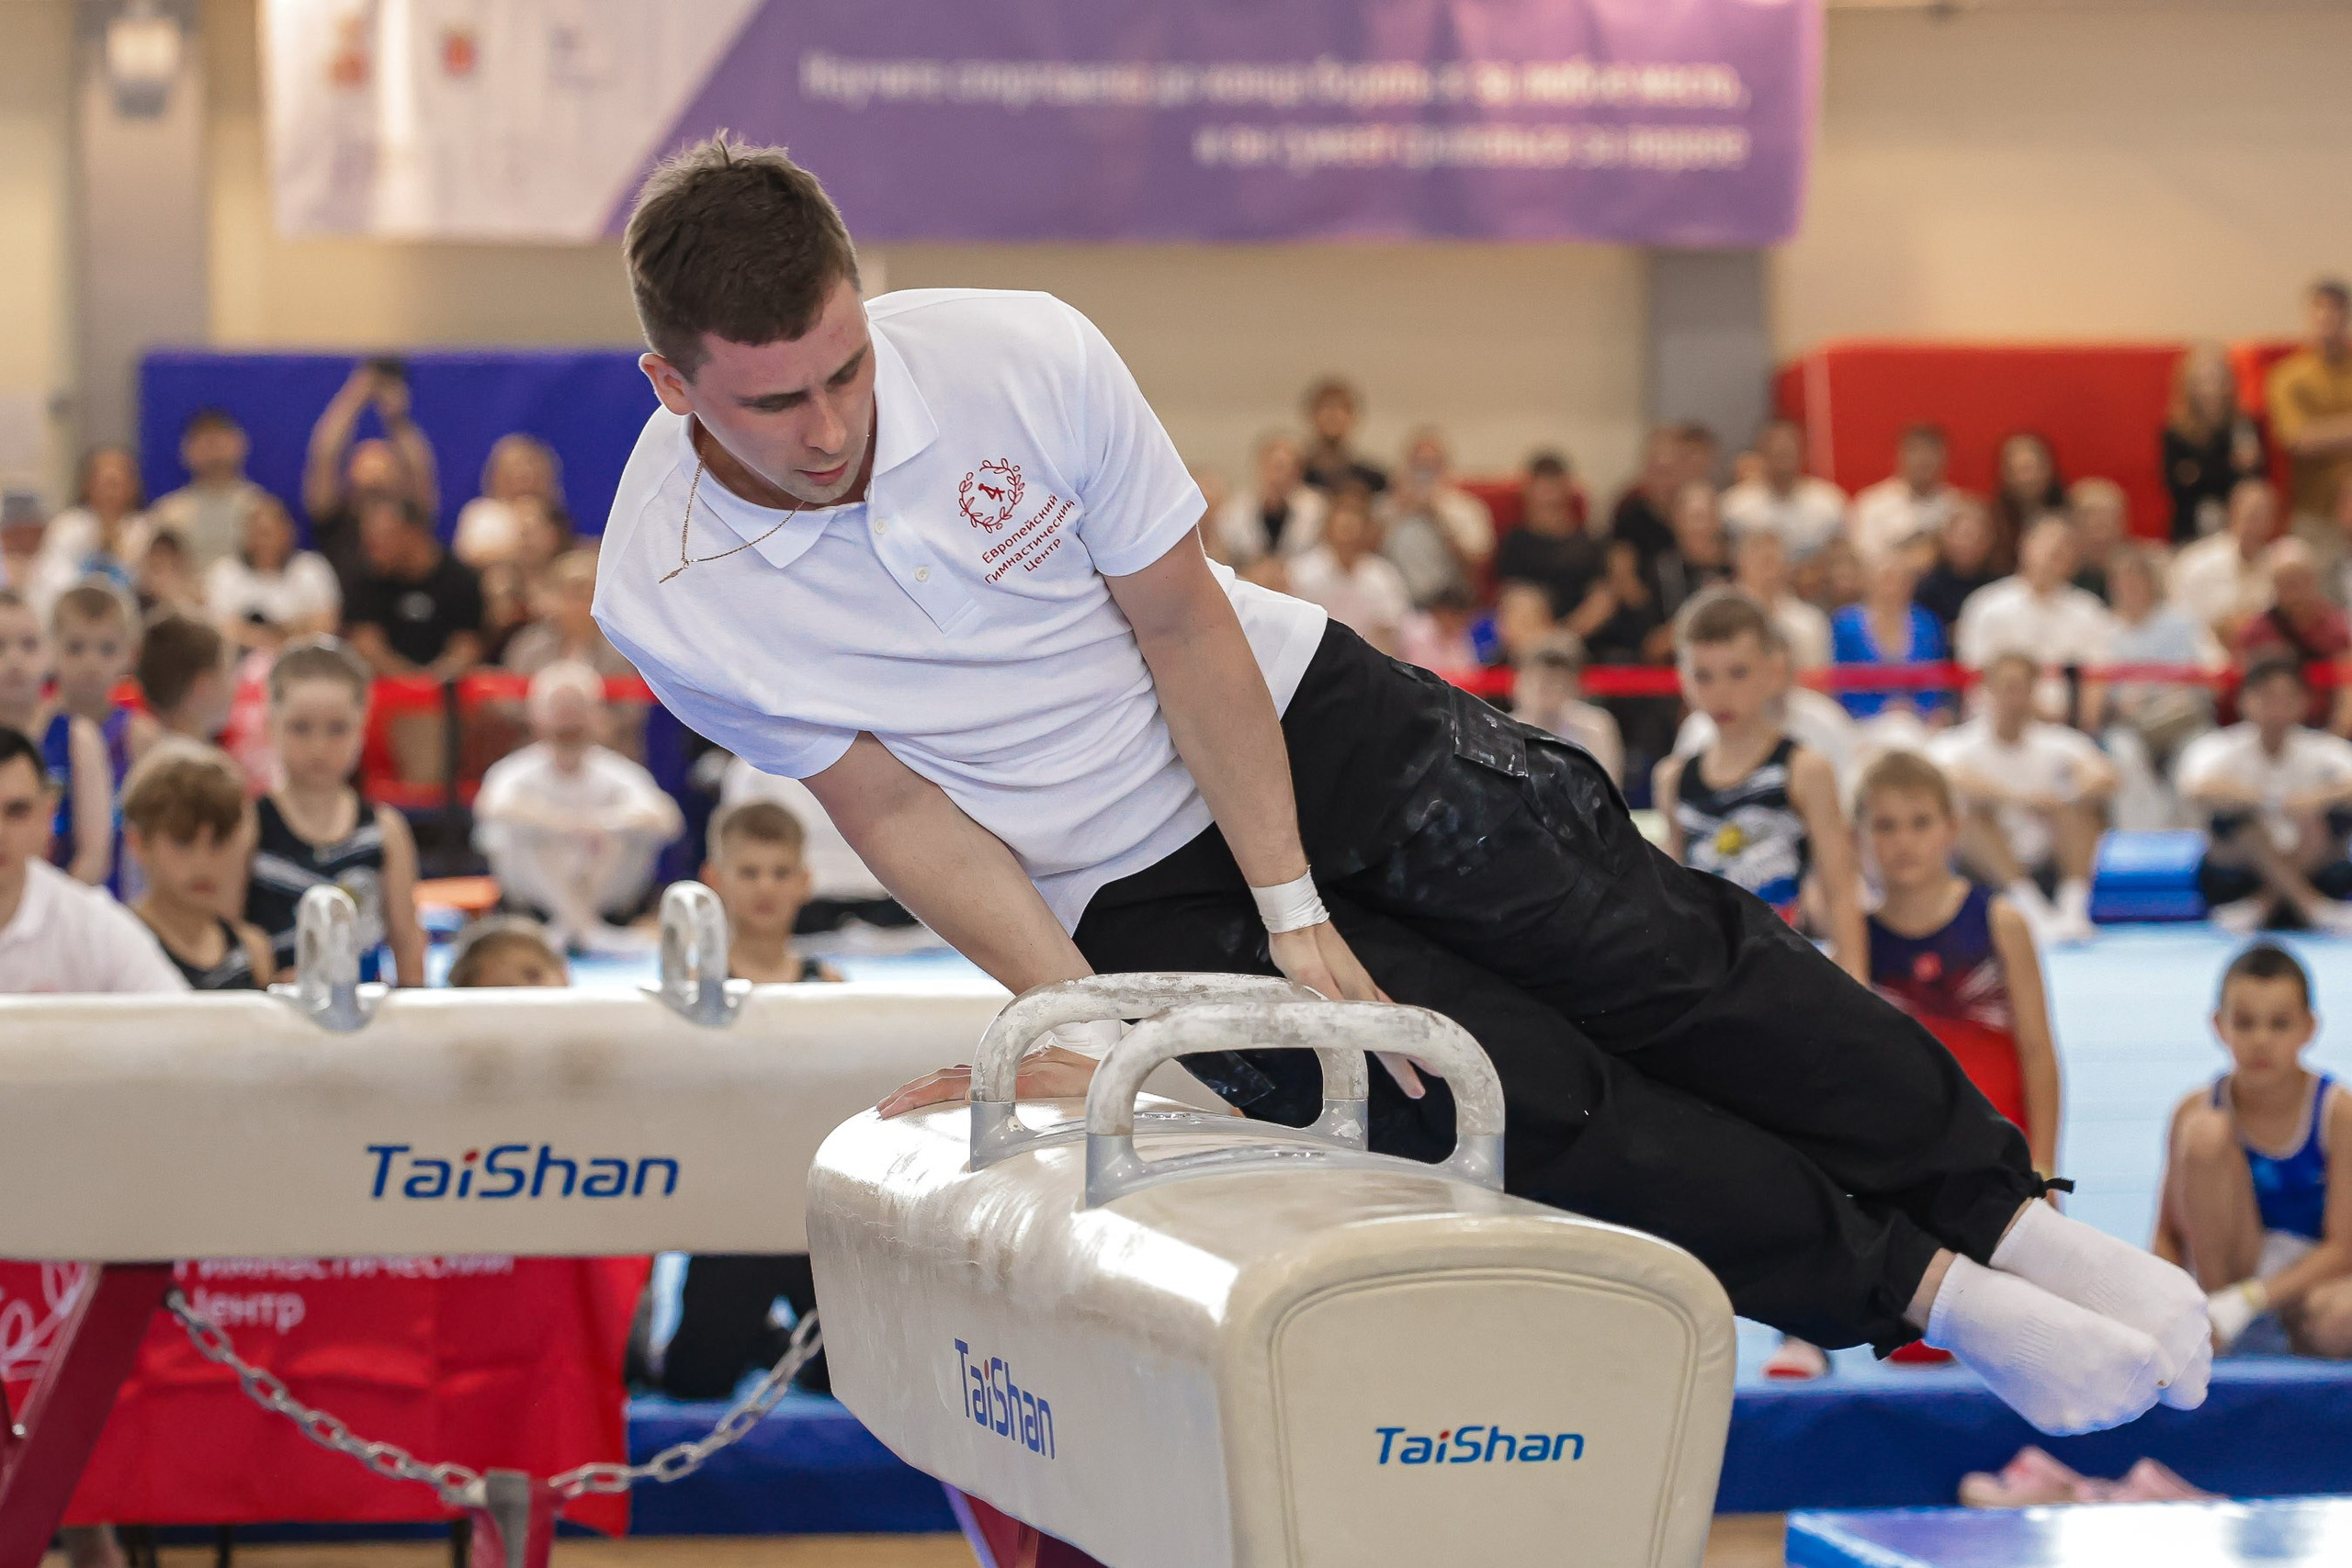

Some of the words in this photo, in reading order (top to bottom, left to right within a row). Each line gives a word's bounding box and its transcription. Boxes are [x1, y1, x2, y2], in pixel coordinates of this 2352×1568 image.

[981, 493, 1058, 564] Европейский
[984, 499, 1075, 584] Гимнастический
[1023, 538, 1061, 572] Центр
[367, 1145, 680, 1198] TaiShan
[954, 1337, 1055, 1460] TaiShan
[1375, 1425, 1584, 1464] TaiShan
